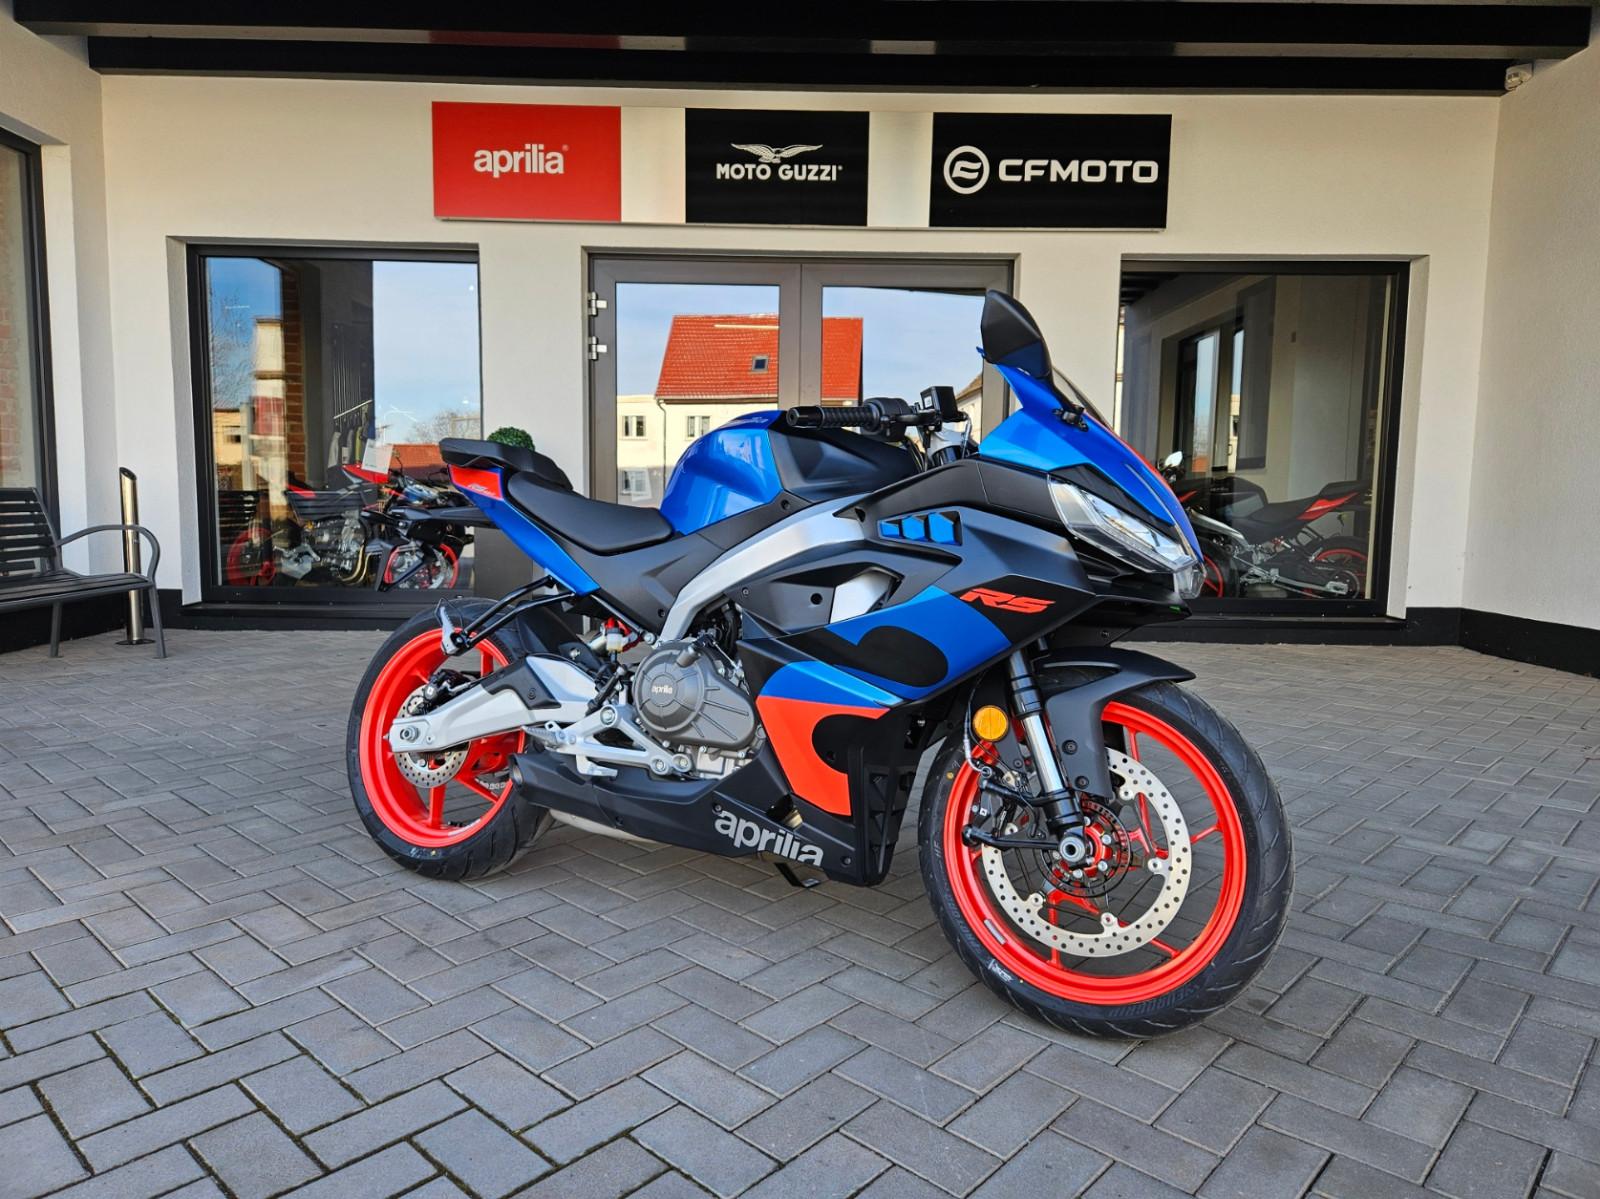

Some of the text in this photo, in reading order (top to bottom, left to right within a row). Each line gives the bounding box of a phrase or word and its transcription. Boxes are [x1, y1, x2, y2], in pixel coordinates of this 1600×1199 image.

[474, 143, 564, 178] aprilia
[716, 163, 838, 181] MOTO GUZZI
[998, 159, 1159, 184] CFMOTO
[960, 588, 1055, 613] RS
[713, 808, 824, 868] aprilia
